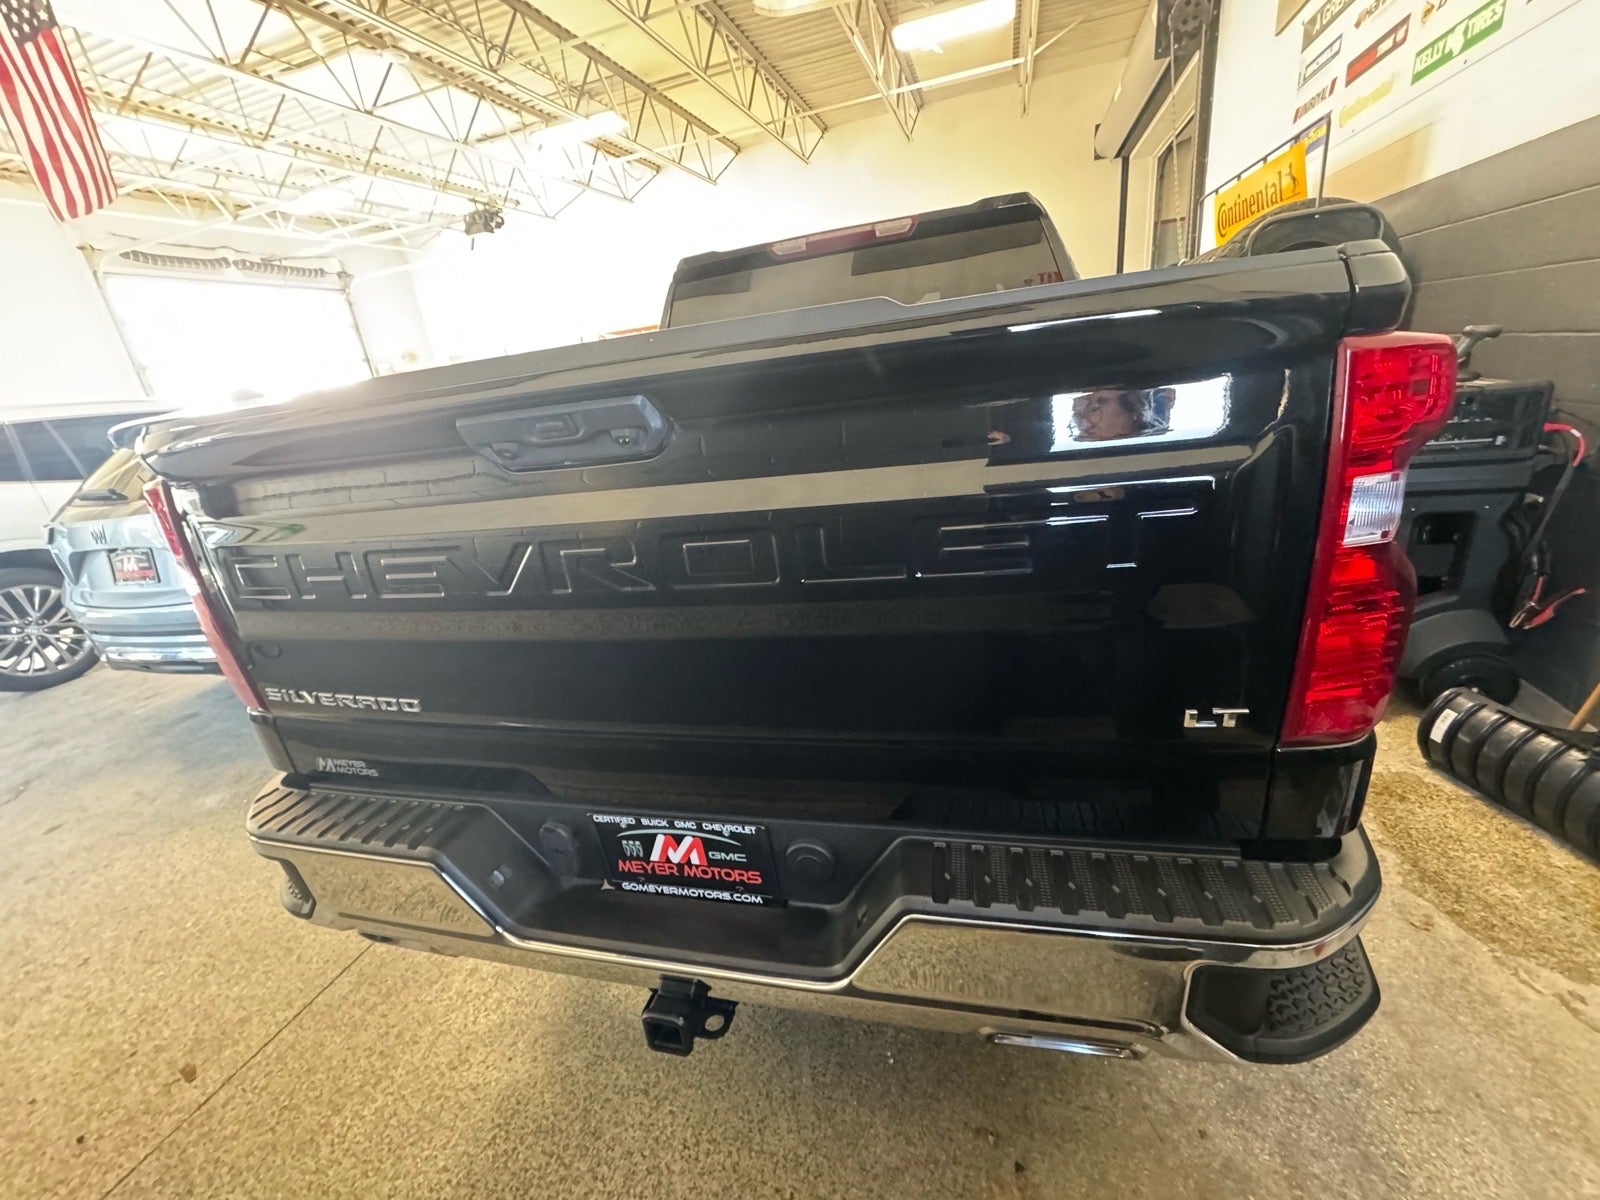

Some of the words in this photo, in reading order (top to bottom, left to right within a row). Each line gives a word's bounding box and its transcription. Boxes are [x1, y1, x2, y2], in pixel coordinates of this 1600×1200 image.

[1413, 36, 1449, 75] KELLY
[1217, 170, 1284, 238] Continental
[224, 498, 1198, 600] CHEVROLET
[264, 687, 422, 713] SILVERADO
[1183, 707, 1250, 728] LT
[334, 759, 366, 769] MEYER
[336, 766, 379, 777] MOTORS
[592, 813, 636, 826] CERTIFIED
[641, 817, 669, 828] BUICK
[674, 820, 697, 831] GMC
[702, 822, 757, 836] CHEVROLET
[708, 851, 748, 863] GMC
[618, 859, 680, 877] MEYER
[684, 866, 763, 885] MOTORS
[621, 881, 764, 905] GOMEYERMOTORS.COM
